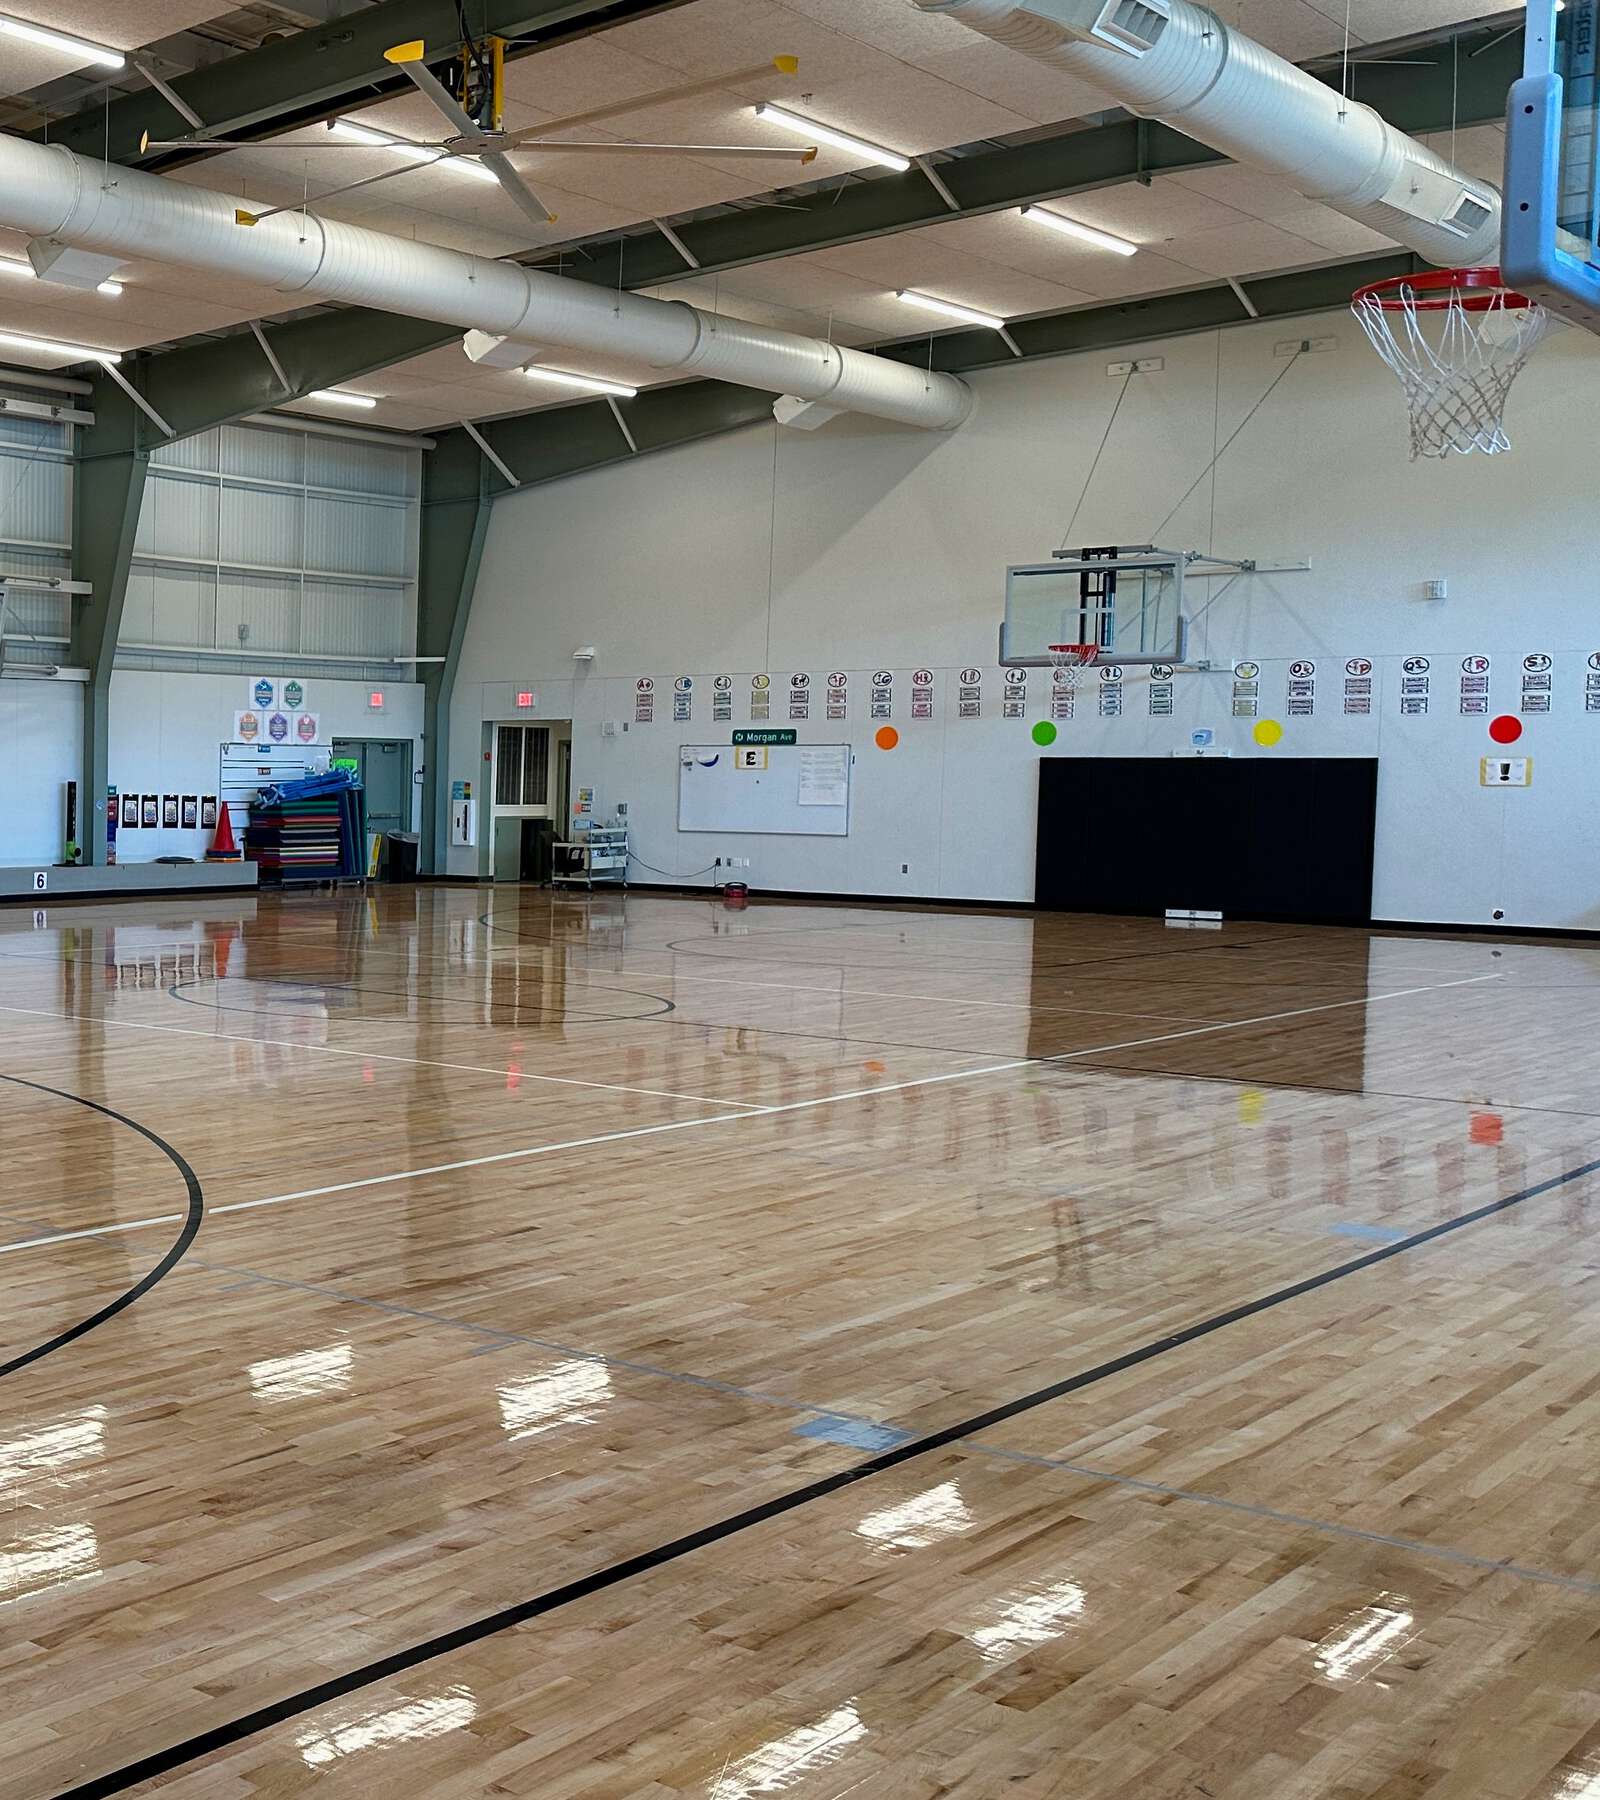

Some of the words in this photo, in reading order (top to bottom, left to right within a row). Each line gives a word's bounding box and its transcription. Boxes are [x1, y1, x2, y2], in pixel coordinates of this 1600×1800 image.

[1405, 661, 1415, 671] Q
[1475, 659, 1486, 670] R
[1527, 656, 1538, 667] S
[1113, 668, 1119, 677] L
[1153, 667, 1162, 675] M
[1293, 663, 1302, 673] O
[1359, 664, 1369, 673] P
[881, 675, 890, 684] G
[915, 674, 923, 682] H
[1016, 672, 1024, 681] J
[638, 680, 645, 688] A
[683, 679, 690, 688] B
[793, 677, 799, 686] E
[746, 733, 777, 743] Morgan
[745, 751, 756, 766] E
[37, 873, 45, 888] 6
